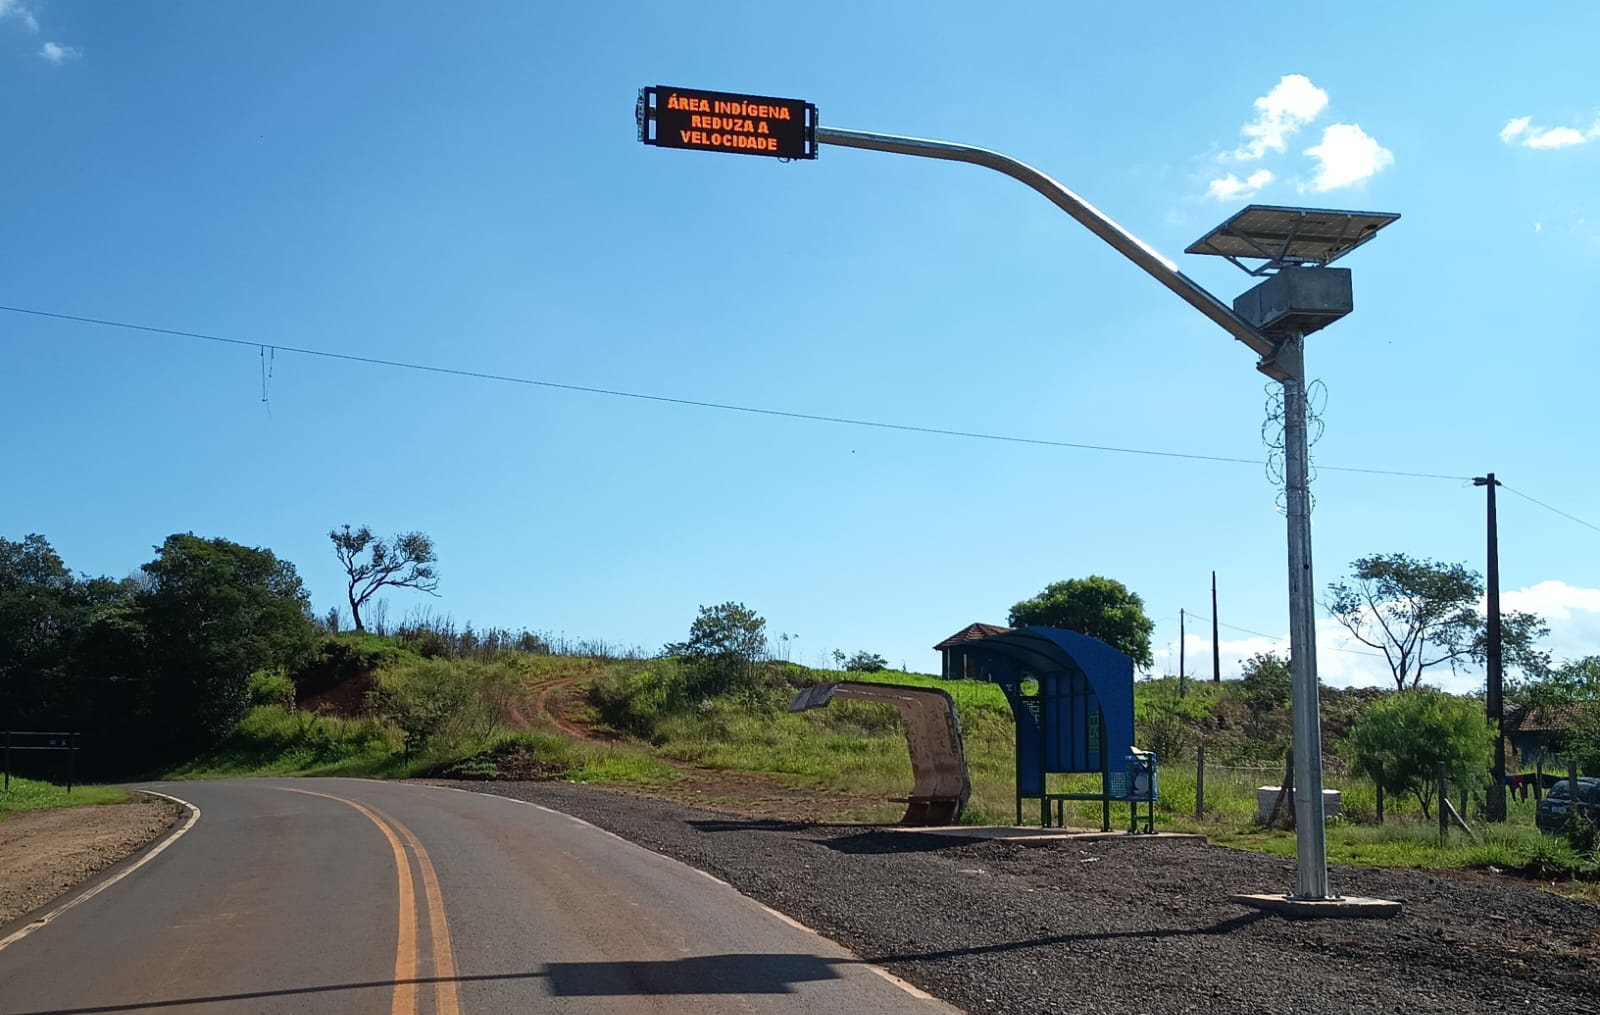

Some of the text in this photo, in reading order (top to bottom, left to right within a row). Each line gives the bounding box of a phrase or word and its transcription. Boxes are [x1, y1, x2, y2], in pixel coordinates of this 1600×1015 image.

[667, 93, 790, 120] ÁREA INDÍGENA
[691, 115, 770, 134] REDUZA A
[680, 130, 777, 150] VELOCIDADE
